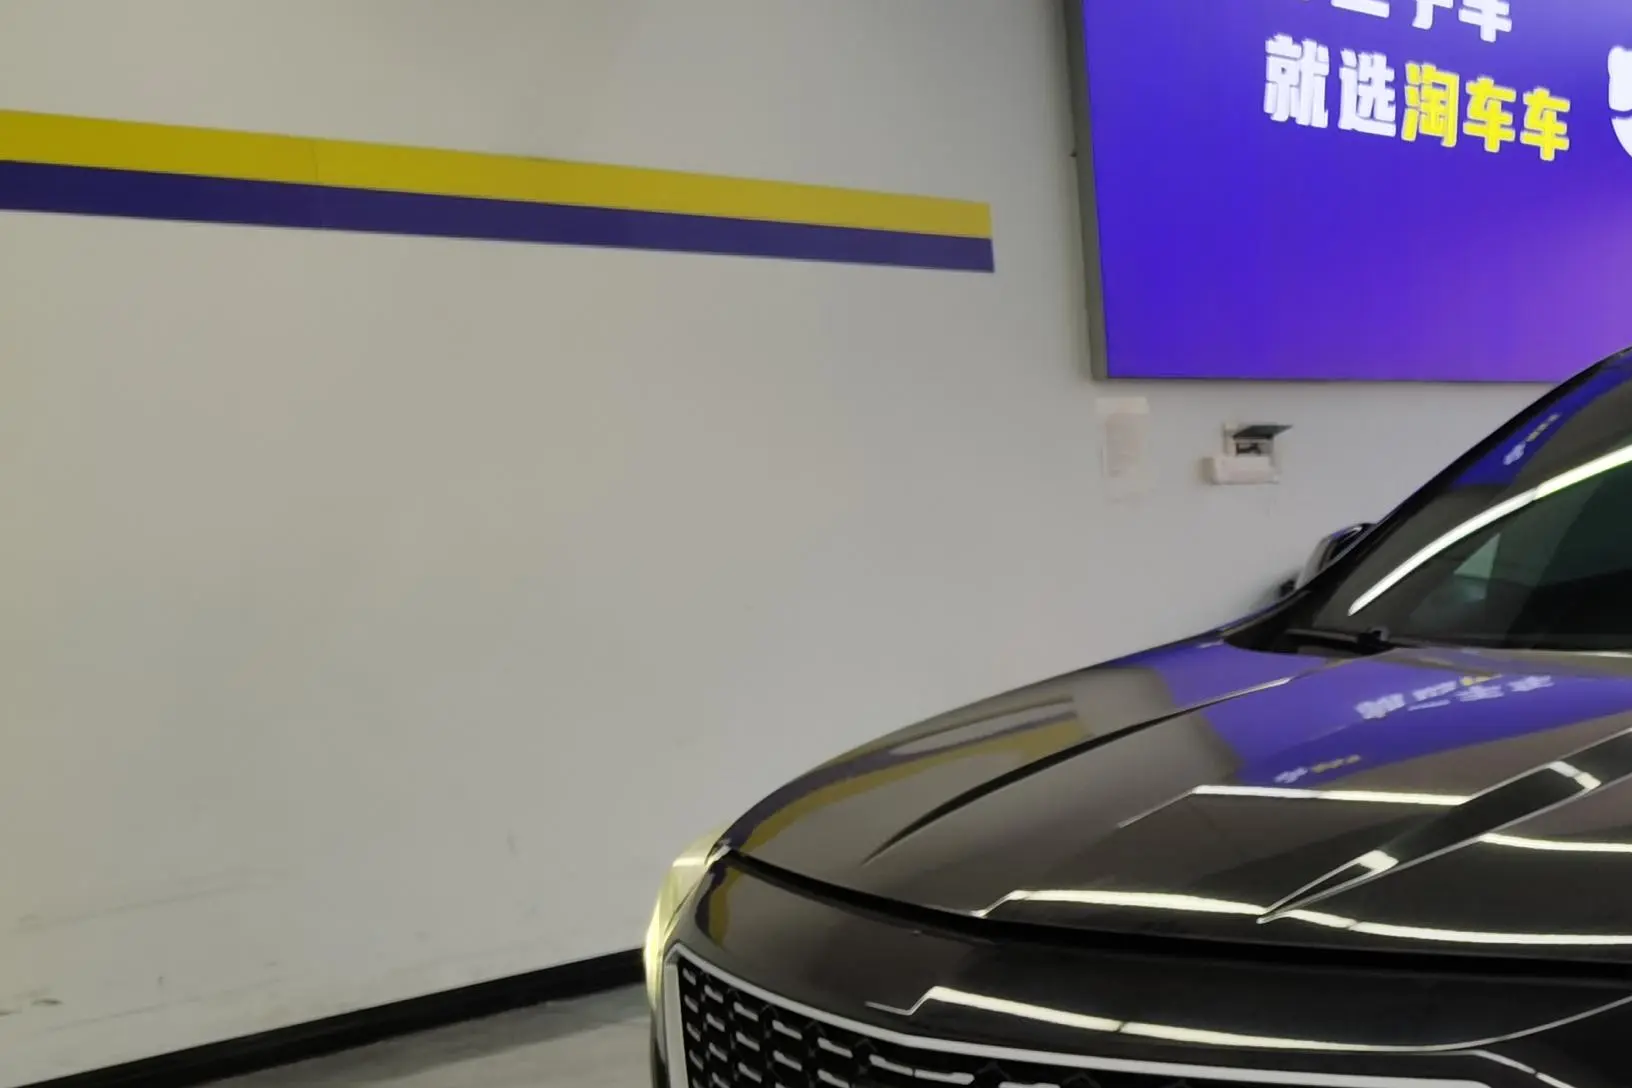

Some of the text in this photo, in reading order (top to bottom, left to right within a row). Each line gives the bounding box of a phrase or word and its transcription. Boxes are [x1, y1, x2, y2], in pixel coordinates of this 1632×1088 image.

[1263, 33, 1571, 162] 就选淘车车
